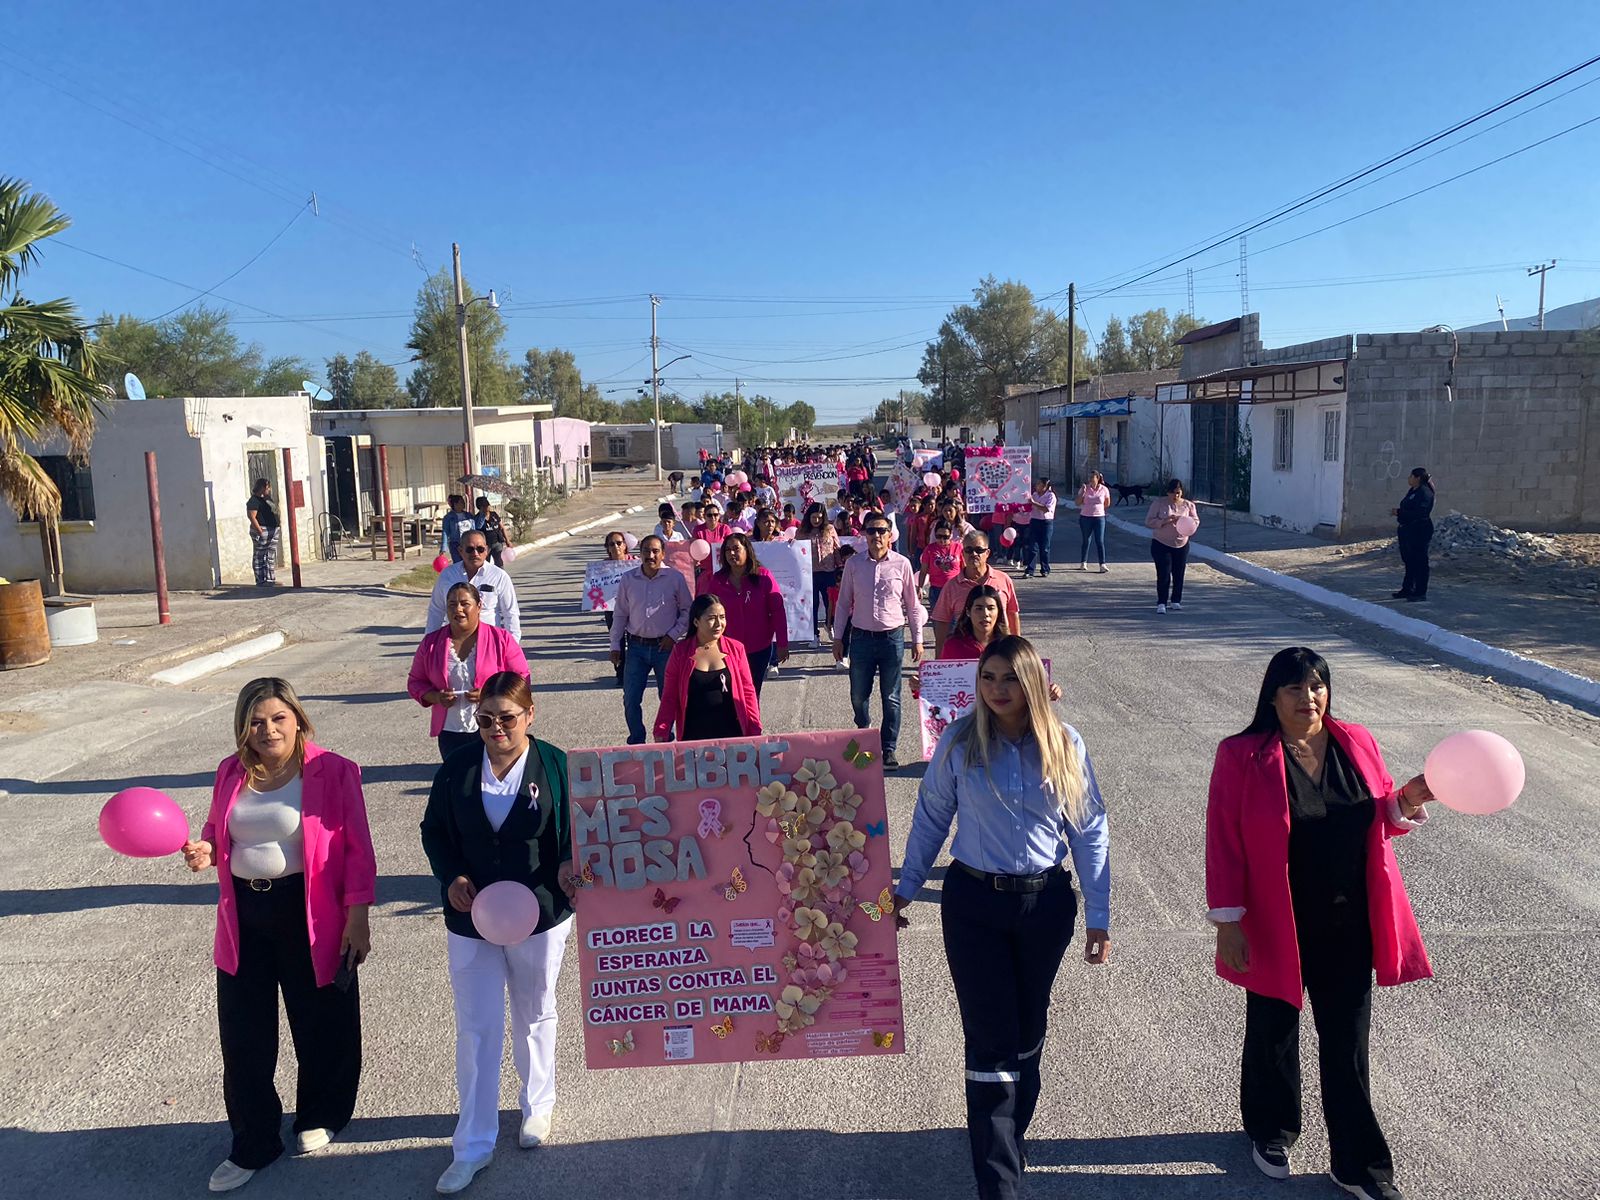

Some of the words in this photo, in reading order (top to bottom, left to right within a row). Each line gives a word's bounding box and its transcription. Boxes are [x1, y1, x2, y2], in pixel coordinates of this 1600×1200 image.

[967, 496, 986, 504] OCT
[968, 504, 991, 512] UBRE
[570, 741, 793, 798] OCTUBRE
[573, 795, 671, 846] MES
[579, 835, 708, 891] ROSA
[591, 925, 674, 947] FLORECE
[689, 922, 713, 938] LA
[599, 948, 707, 971] ESPERANZA
[592, 977, 661, 998] JUNTAS
[668, 970, 746, 990] CONTRA
[753, 967, 775, 982] EL
[589, 1003, 667, 1023] CÁNCER
[677, 1001, 702, 1017] DE
[713, 995, 771, 1012] MAMA
